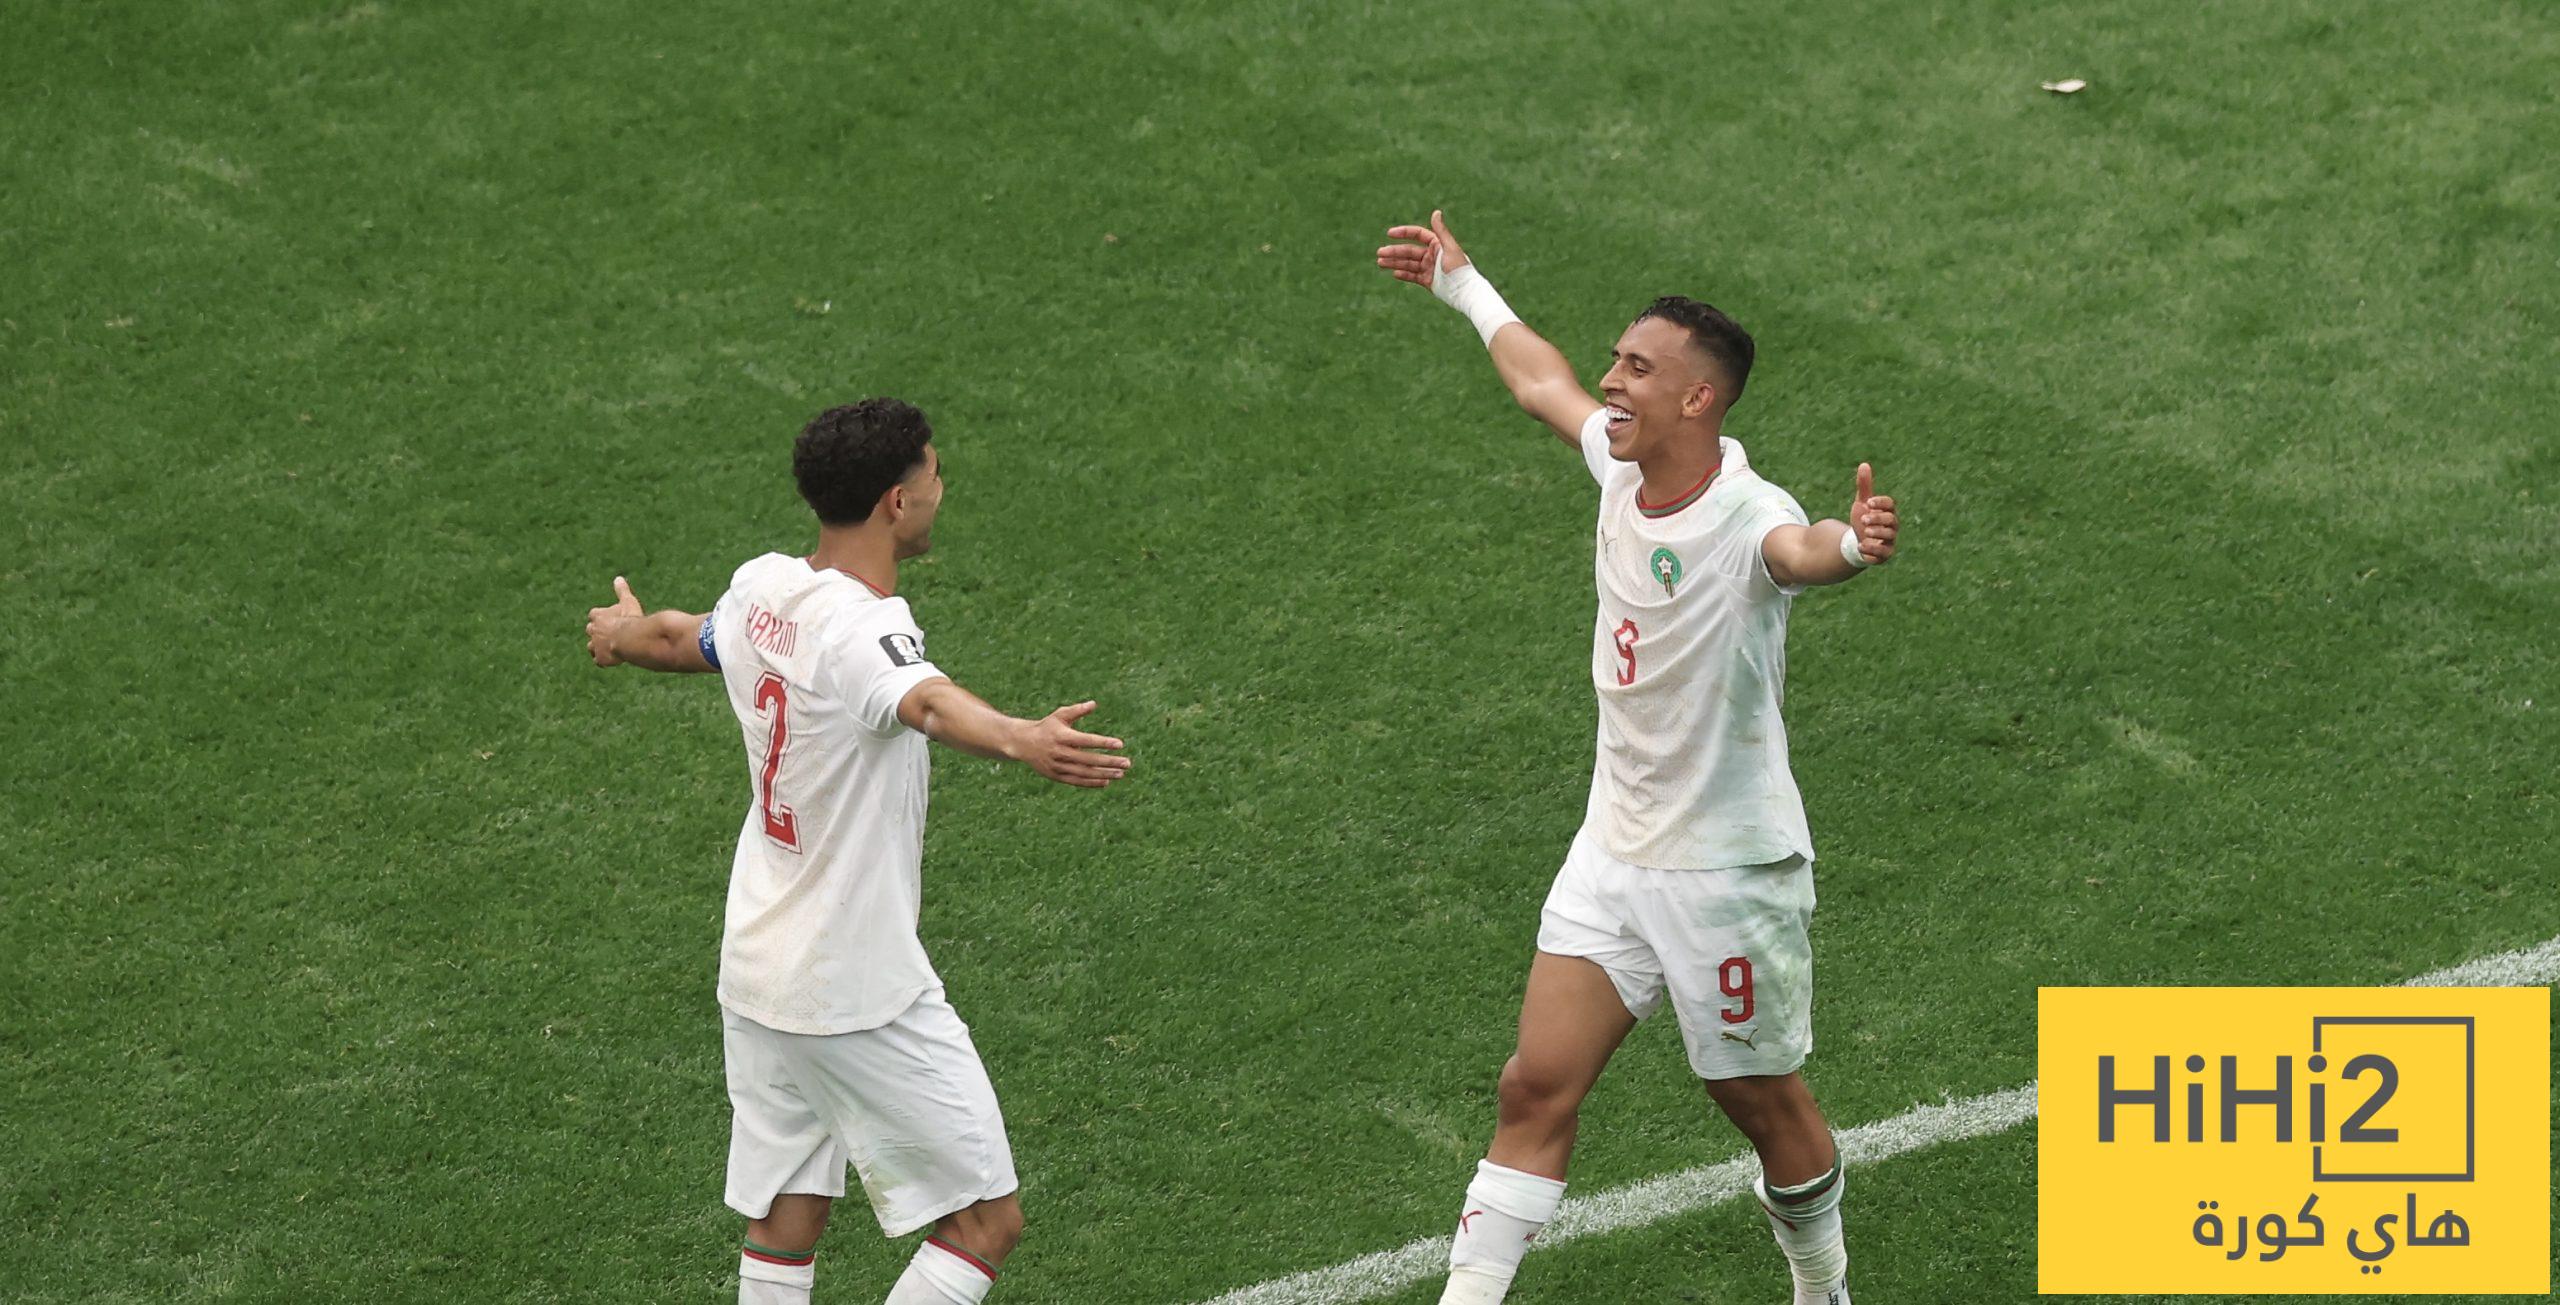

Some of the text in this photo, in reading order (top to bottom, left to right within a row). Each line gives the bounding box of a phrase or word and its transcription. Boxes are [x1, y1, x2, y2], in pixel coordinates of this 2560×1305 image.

[1613, 618, 1640, 687] 9
[754, 670, 803, 855] 2
[1718, 956, 1755, 1025] 9
